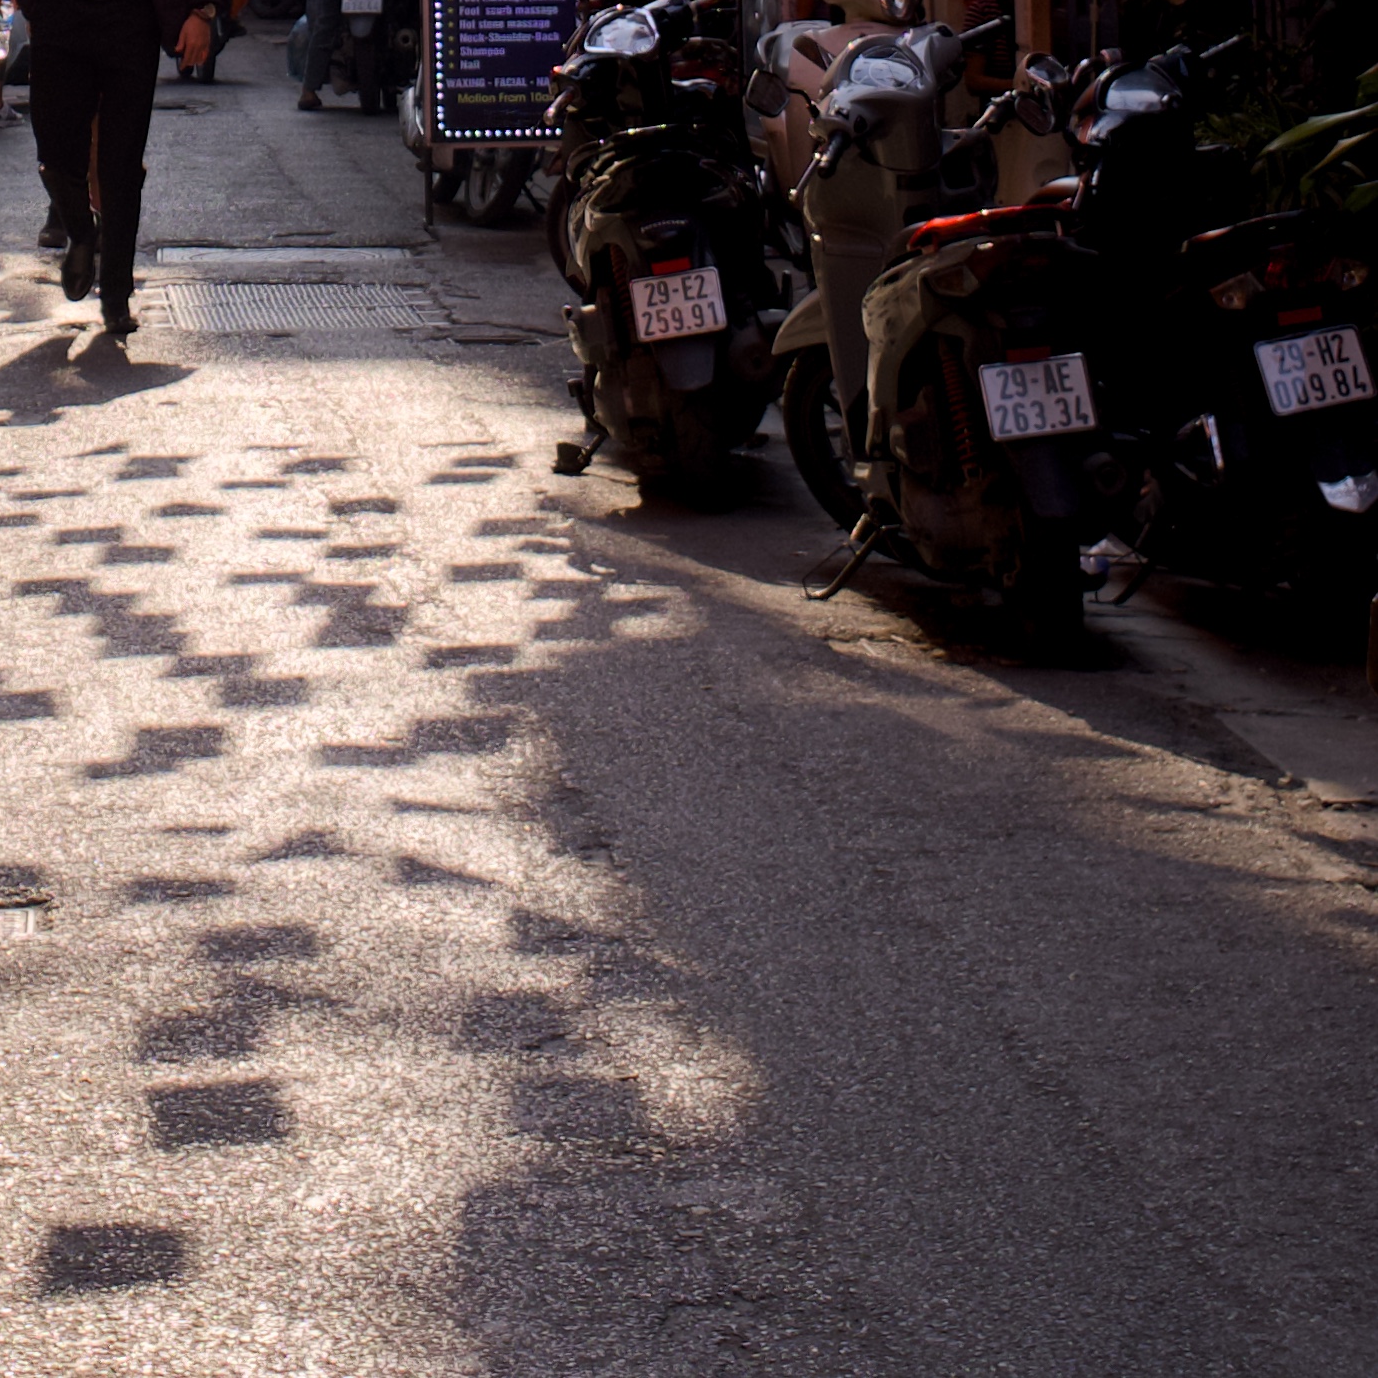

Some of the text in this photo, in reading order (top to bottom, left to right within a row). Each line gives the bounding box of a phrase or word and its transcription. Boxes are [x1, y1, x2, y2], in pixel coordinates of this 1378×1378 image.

[458, 5, 480, 16] Foot
[458, 19, 476, 30] Hot
[446, 77, 486, 88] WAXING
[494, 77, 528, 88] FACIAL
[644, 274, 708, 307] 29-E2
[642, 301, 719, 336] 259.91
[1272, 334, 1350, 375] 29-H2
[996, 362, 1073, 400] 29-AE
[1274, 365, 1366, 409] 009.84
[994, 395, 1089, 435] 263.34
